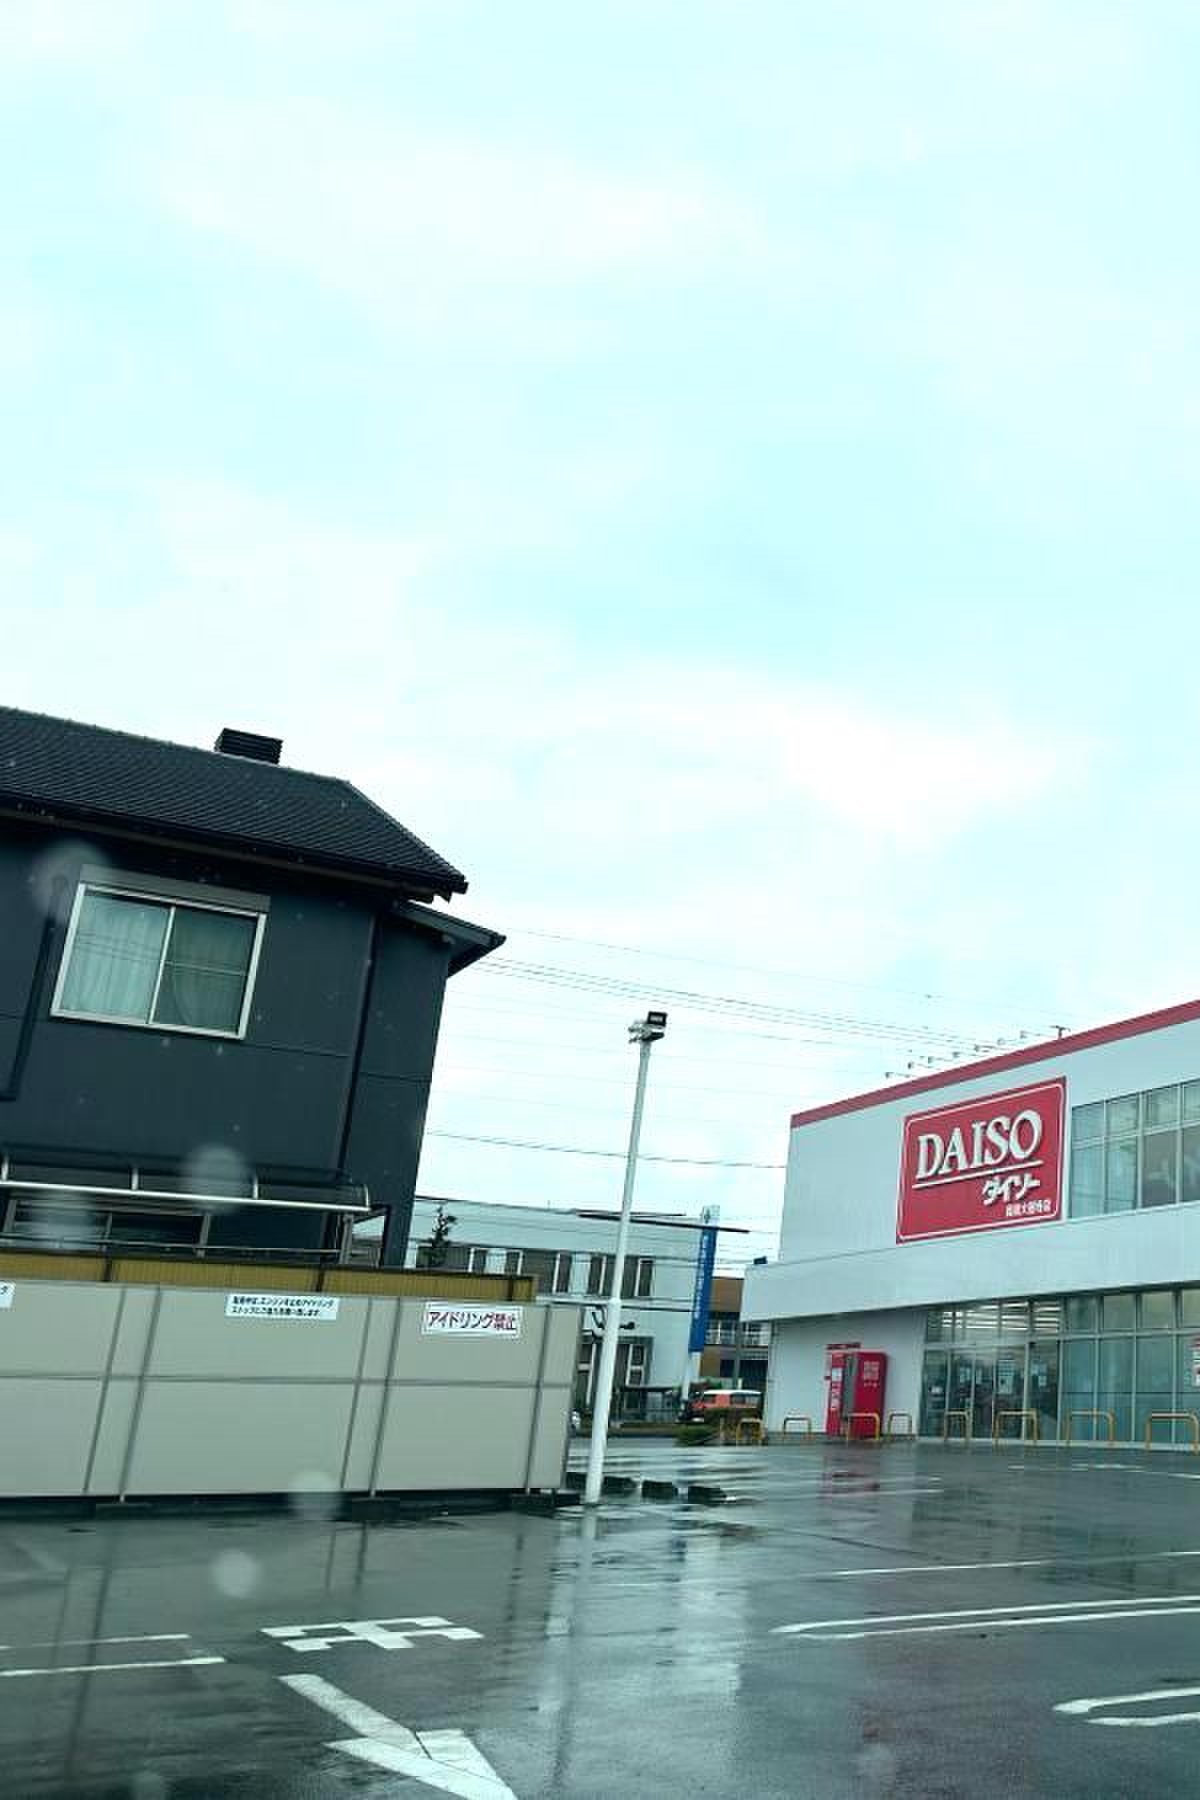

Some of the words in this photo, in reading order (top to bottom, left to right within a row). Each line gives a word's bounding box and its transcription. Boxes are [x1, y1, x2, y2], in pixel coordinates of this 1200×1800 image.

[916, 1110, 1042, 1179] DAISO
[982, 1173, 1041, 1205] ダイソー
[429, 1311, 516, 1330] アイドリング禁止
